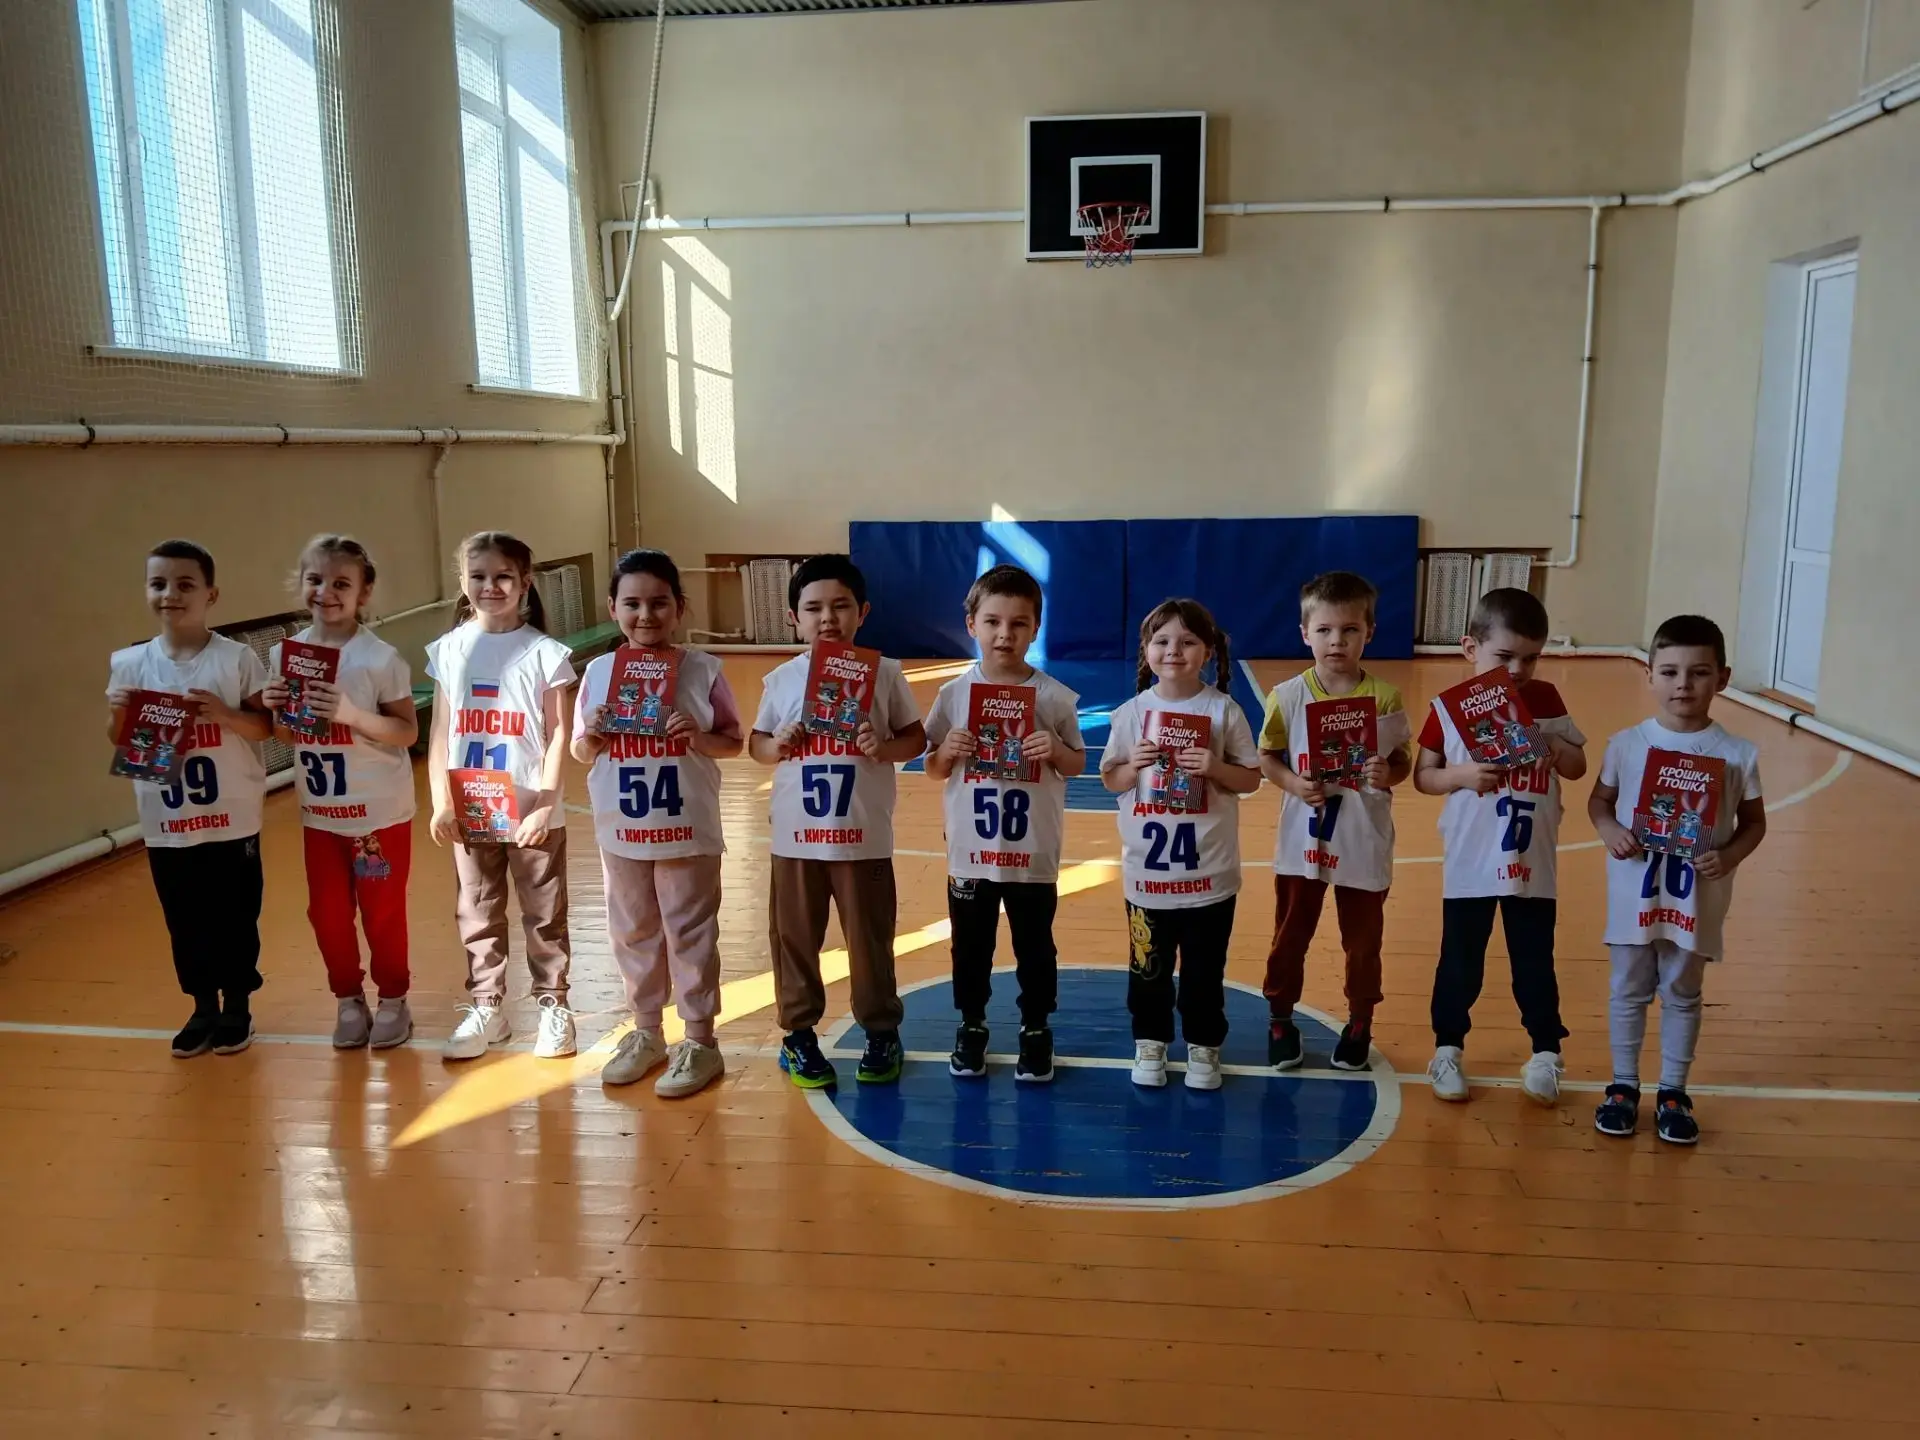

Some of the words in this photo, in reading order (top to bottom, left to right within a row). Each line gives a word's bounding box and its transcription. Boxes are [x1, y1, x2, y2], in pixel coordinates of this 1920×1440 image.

[625, 661, 671, 671] КРОШКА-
[623, 670, 665, 680] ГТОШКА
[982, 698, 1028, 711] КРОШКА-
[1460, 685, 1508, 710] КРОШКА-
[141, 703, 190, 719] КРОШКА-
[981, 707, 1023, 719] ГТОШКА
[1465, 695, 1508, 719] ГТОШКА
[138, 712, 182, 727] ГТОШКА
[455, 708, 525, 737] ДЮСШ
[1320, 710, 1369, 725] КРОШКА-
[1321, 720, 1364, 732] ГТОШКА
[1159, 735, 1195, 748] ТОШКА
[300, 751, 347, 797] 37
[1658, 766, 1714, 783] КРОШКА-
[618, 765, 684, 819] 54
[801, 764, 856, 818] 57
[1656, 776, 1706, 793] ГТОШКА
[973, 787, 1030, 842] 58
[625, 826, 693, 843] КИРЕЕВСК
[804, 828, 863, 844] КИРЕЕВСК
[1142, 821, 1200, 872] 24
[1145, 878, 1212, 894] КИРЕЕВСК
